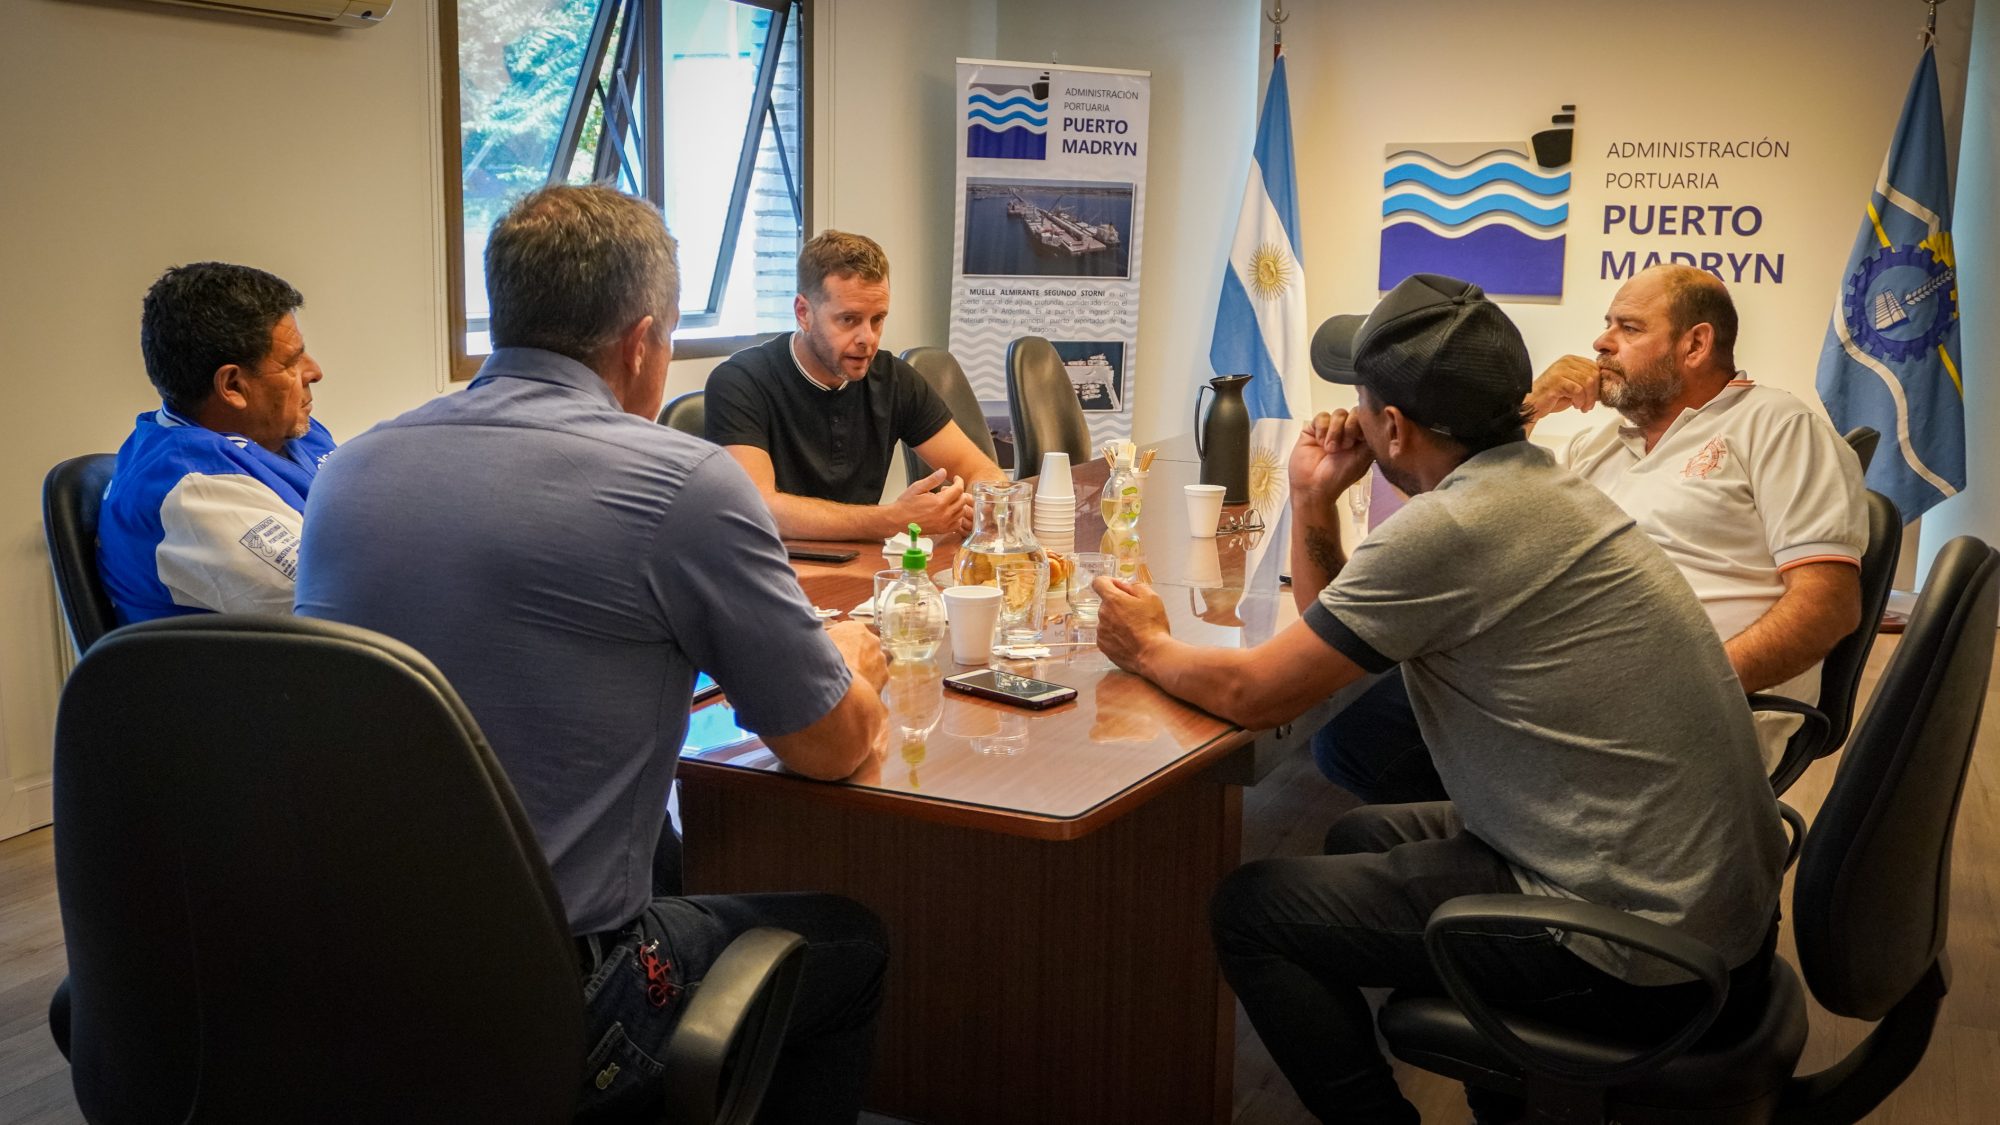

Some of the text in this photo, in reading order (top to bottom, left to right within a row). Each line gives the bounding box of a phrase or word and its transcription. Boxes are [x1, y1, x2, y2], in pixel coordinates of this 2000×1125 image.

[1065, 87, 1139, 100] ADMINISTRACIÓN
[1064, 102, 1110, 112] PORTUARIA
[1063, 117, 1128, 134] PUERTO
[1062, 138, 1138, 156] MADRYN
[1606, 136, 1790, 158] ADMINISTRACIÓN
[1605, 172, 1720, 189] PORTUARIA
[1603, 204, 1763, 237] PUERTO
[969, 288, 996, 296] MUELLE
[1000, 288, 1040, 297] ALMIRANTE
[1044, 289, 1077, 297] SEGUNDO
[1080, 289, 1106, 297] STORNI
